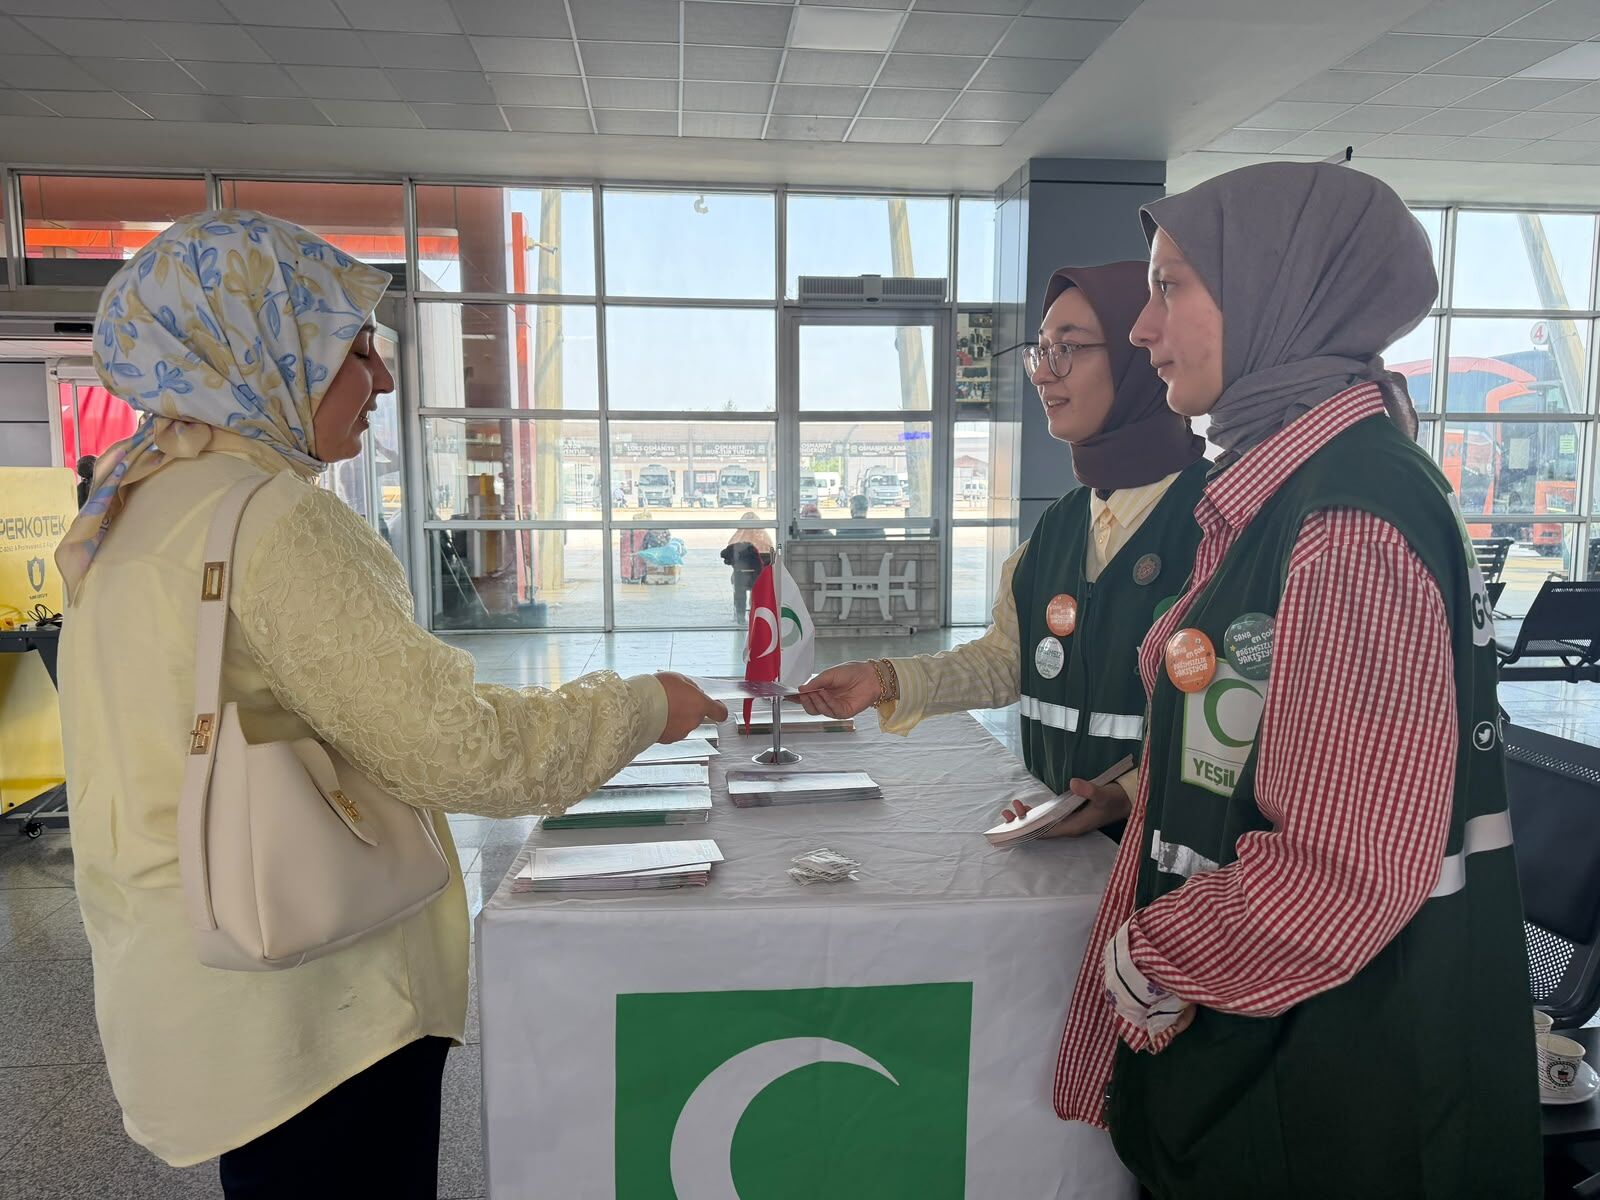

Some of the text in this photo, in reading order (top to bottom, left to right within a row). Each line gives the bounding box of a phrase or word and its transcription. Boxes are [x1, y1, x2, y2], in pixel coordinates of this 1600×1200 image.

[1533, 325, 1544, 341] 4
[1233, 631, 1251, 642] SANA
[1235, 641, 1274, 658] BAĞIMSIZLI
